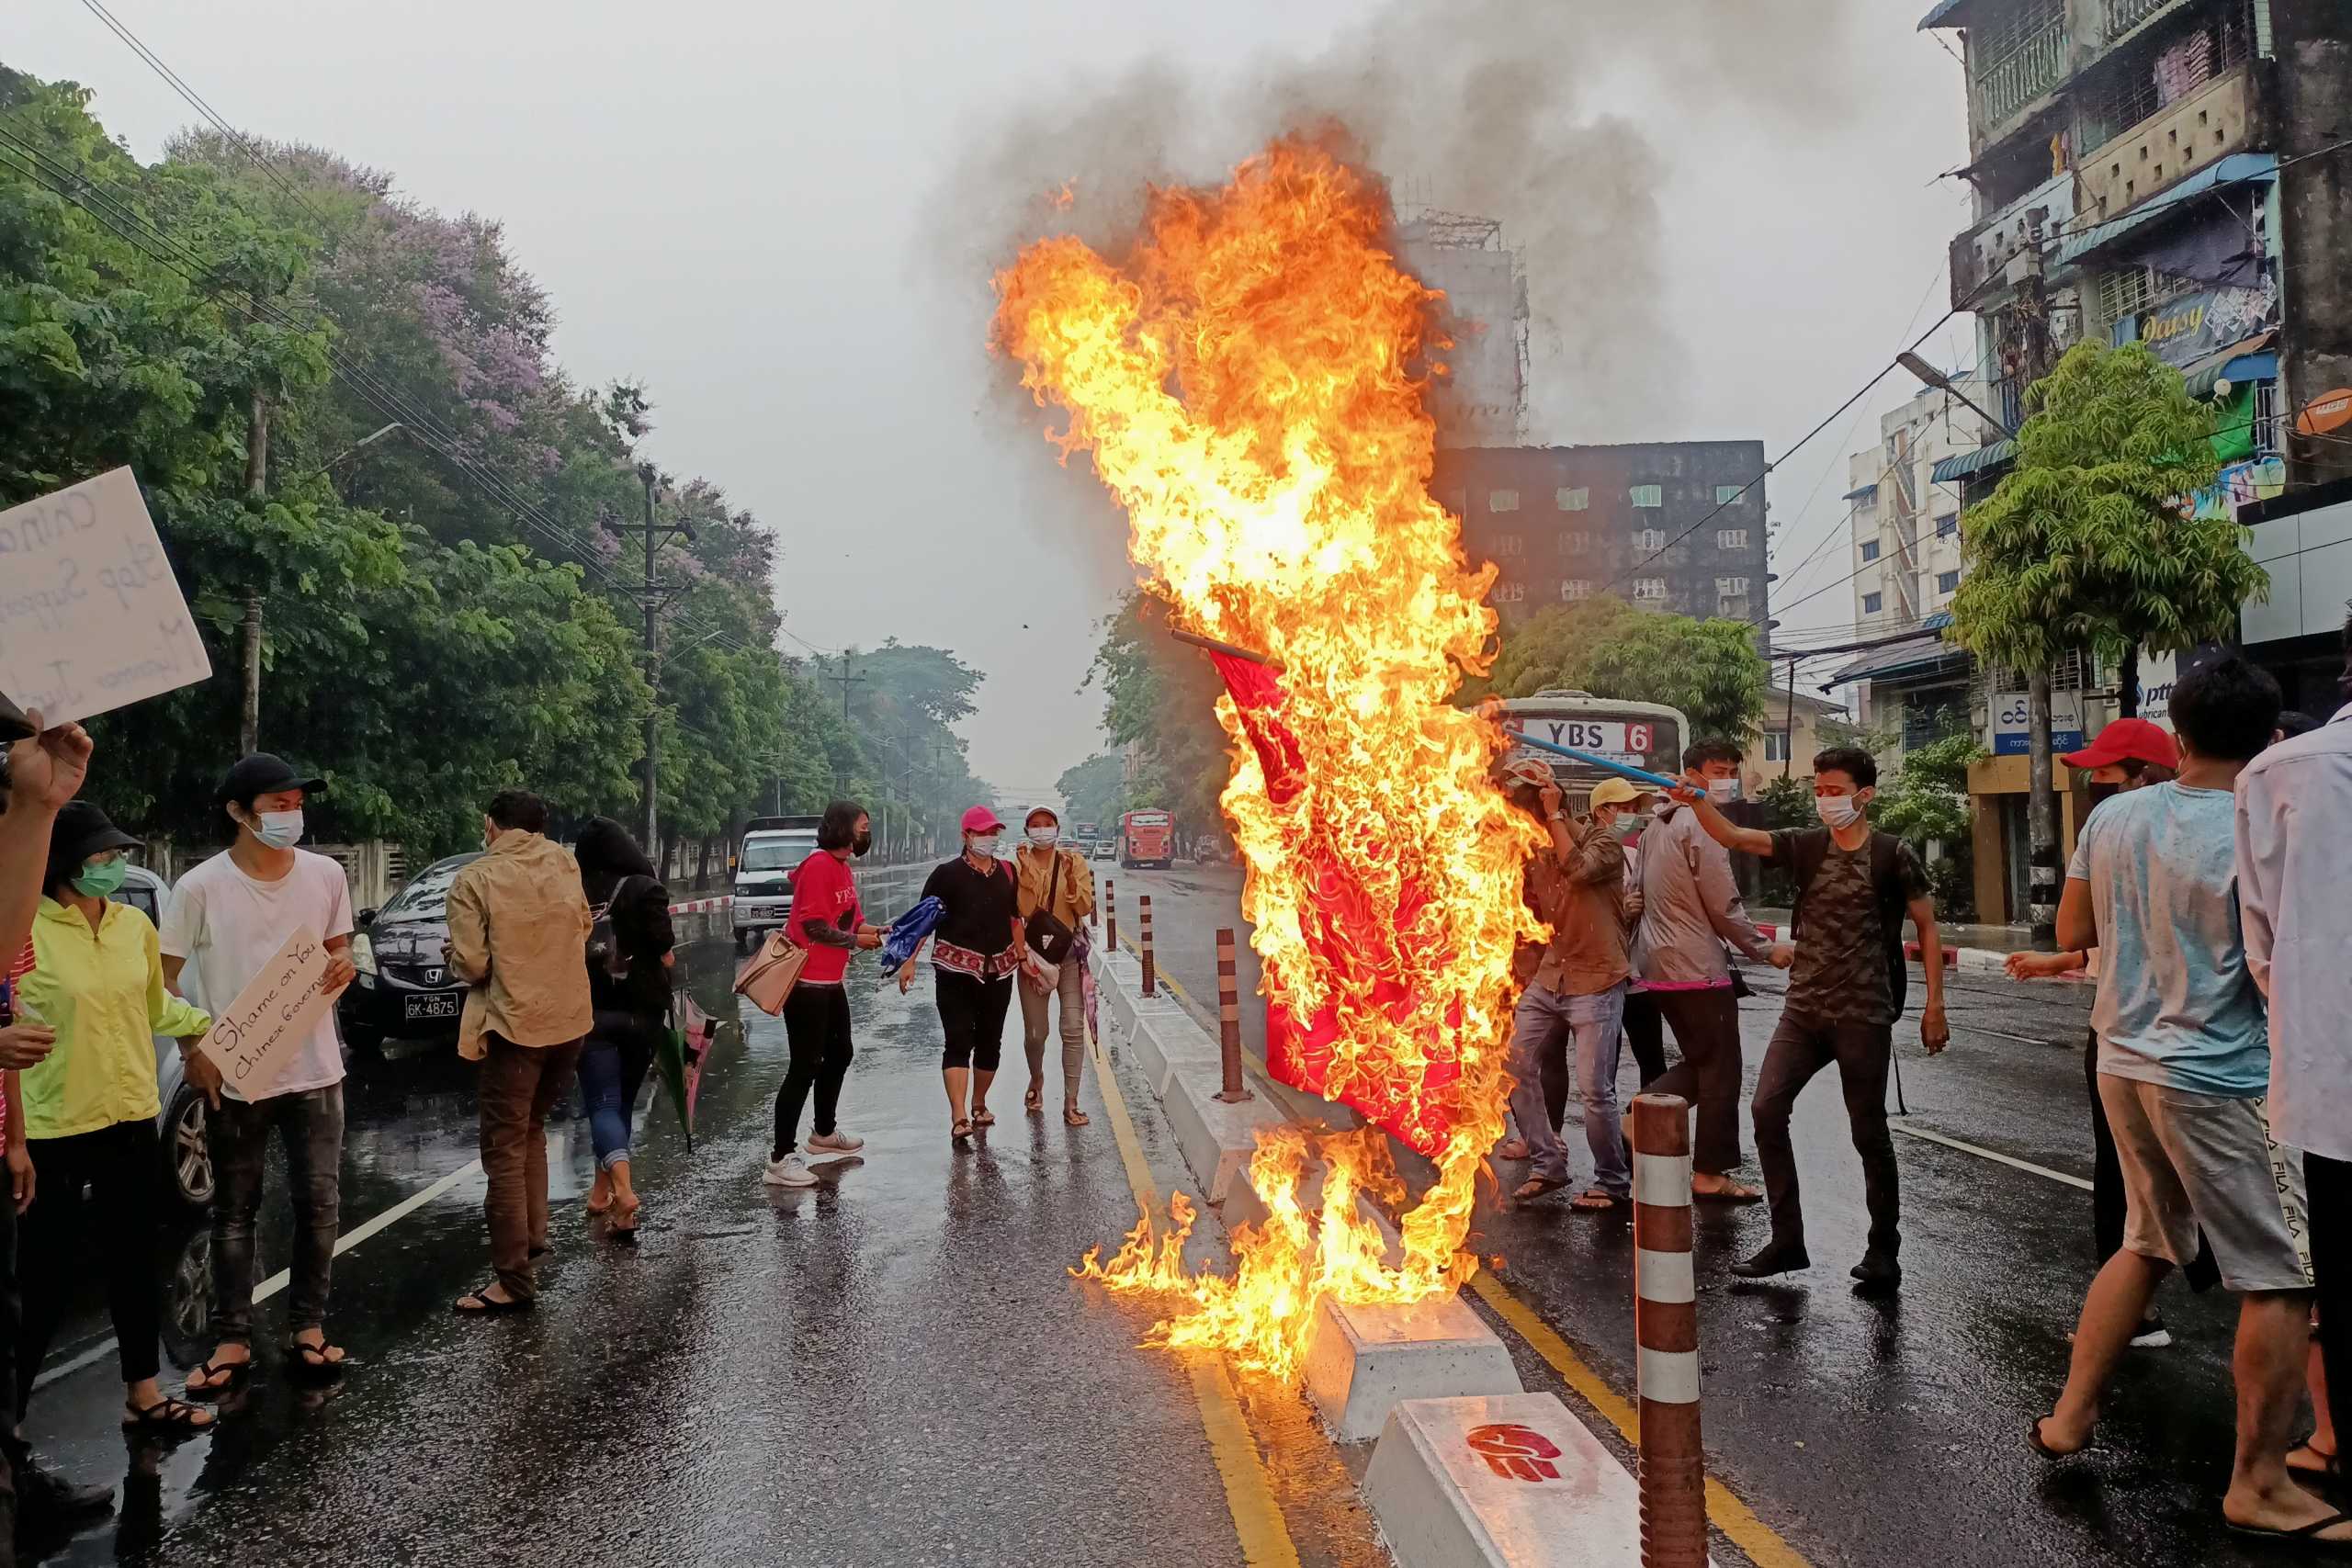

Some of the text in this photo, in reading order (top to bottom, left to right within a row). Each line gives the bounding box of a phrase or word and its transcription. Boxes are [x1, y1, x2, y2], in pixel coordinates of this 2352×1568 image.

[2138, 708, 2168, 719] ubrican
[1548, 723, 1603, 748] YBS
[1629, 725, 1647, 751] 6
[213, 942, 316, 1053] Shame on You
[408, 1002, 455, 1016] 6K-4875
[235, 976, 325, 1080] Chinese Govern
[2272, 1162, 2290, 1193] FILA
[2283, 1206, 2301, 1239] FILA
